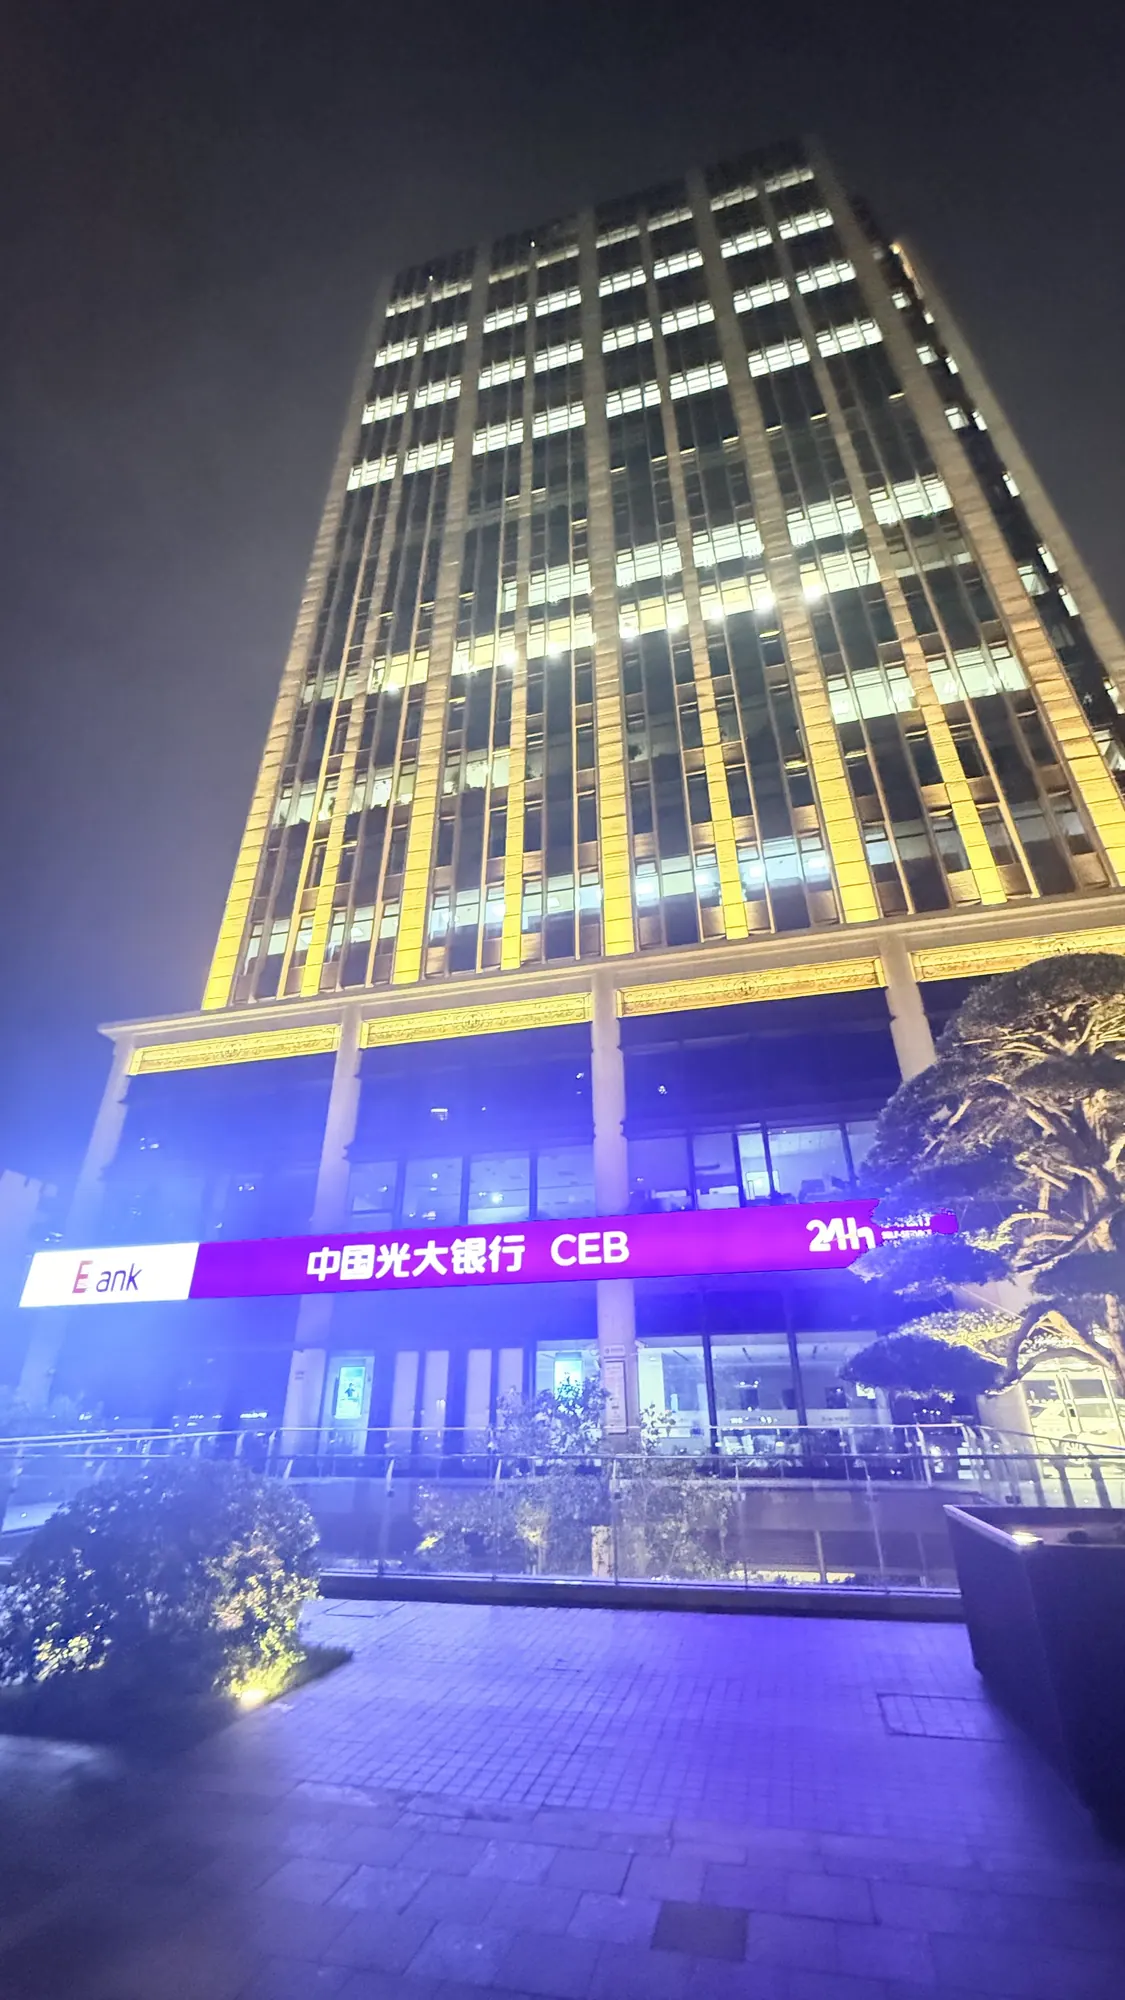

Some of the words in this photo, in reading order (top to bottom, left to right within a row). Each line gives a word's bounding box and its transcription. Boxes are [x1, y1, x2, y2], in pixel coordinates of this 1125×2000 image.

[306, 1234, 525, 1282] 中国光大银行
[550, 1230, 630, 1267] CEB
[806, 1217, 876, 1252] 24h
